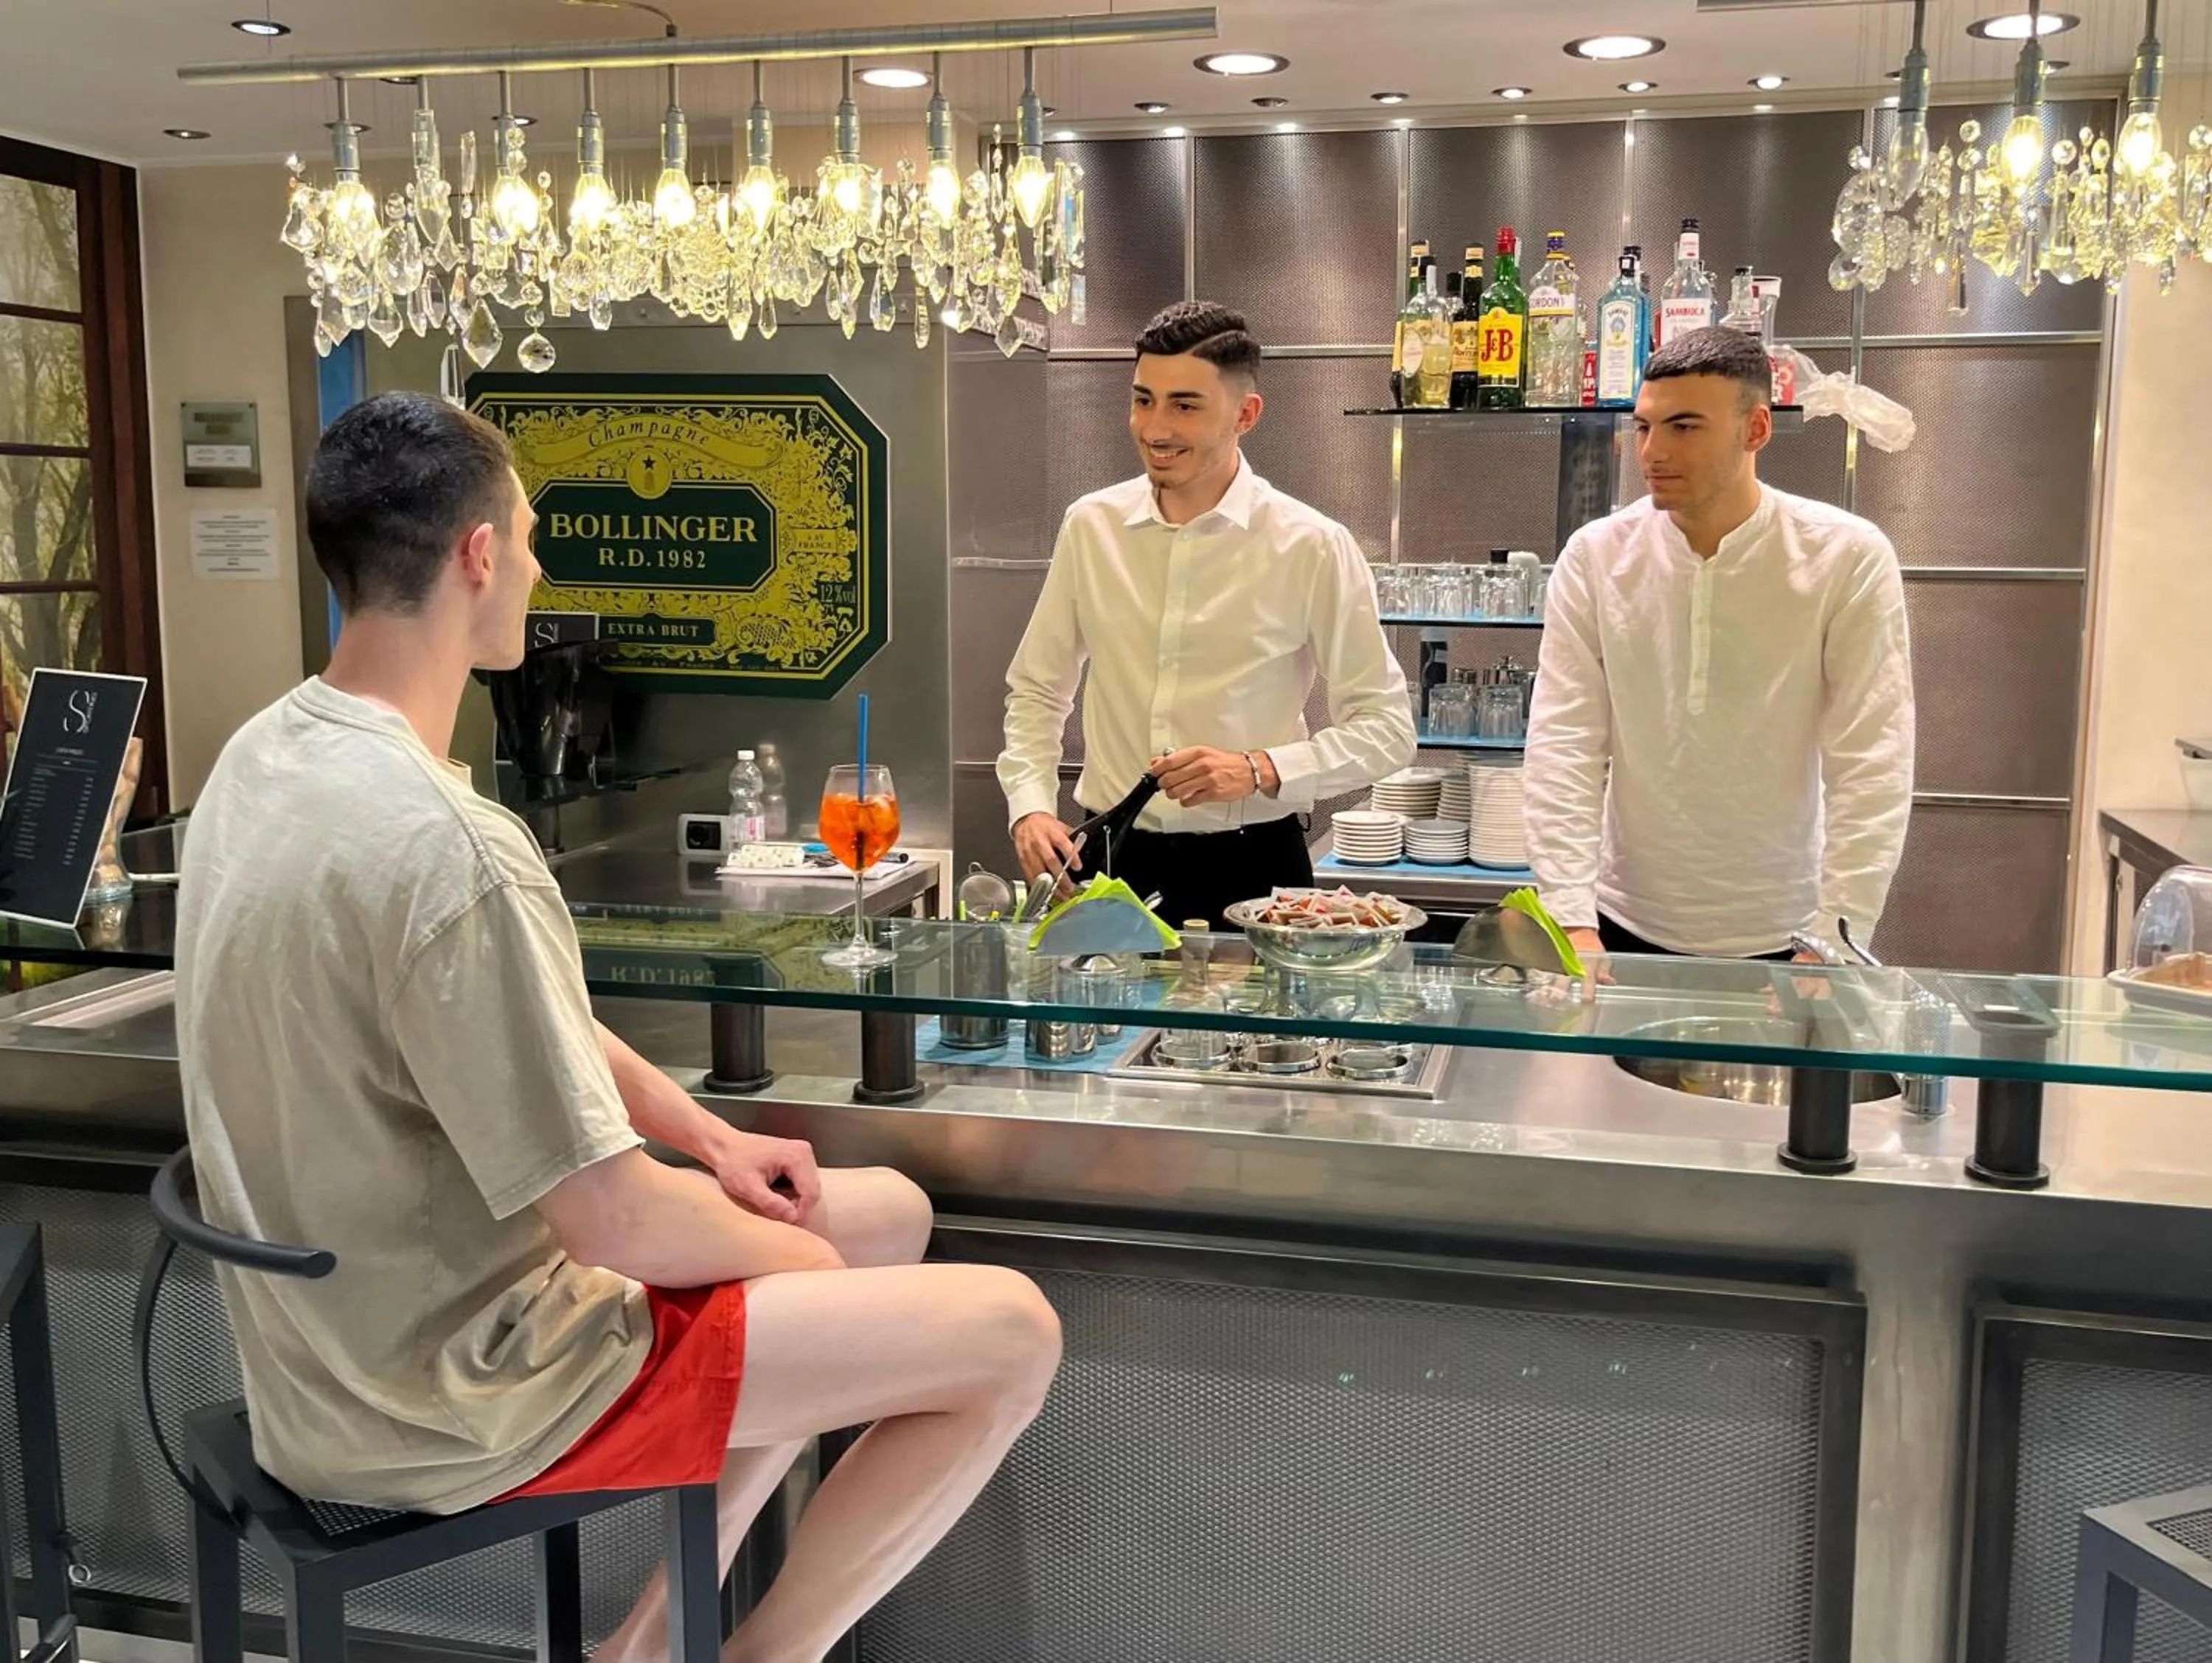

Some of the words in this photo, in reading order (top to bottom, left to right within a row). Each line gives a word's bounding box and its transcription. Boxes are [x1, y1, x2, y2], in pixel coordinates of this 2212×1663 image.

[589, 421, 709, 447] Champagne
[549, 513, 758, 543] BOLLINGER
[608, 623, 655, 635] EXTRA
[661, 624, 700, 637] BRUT
